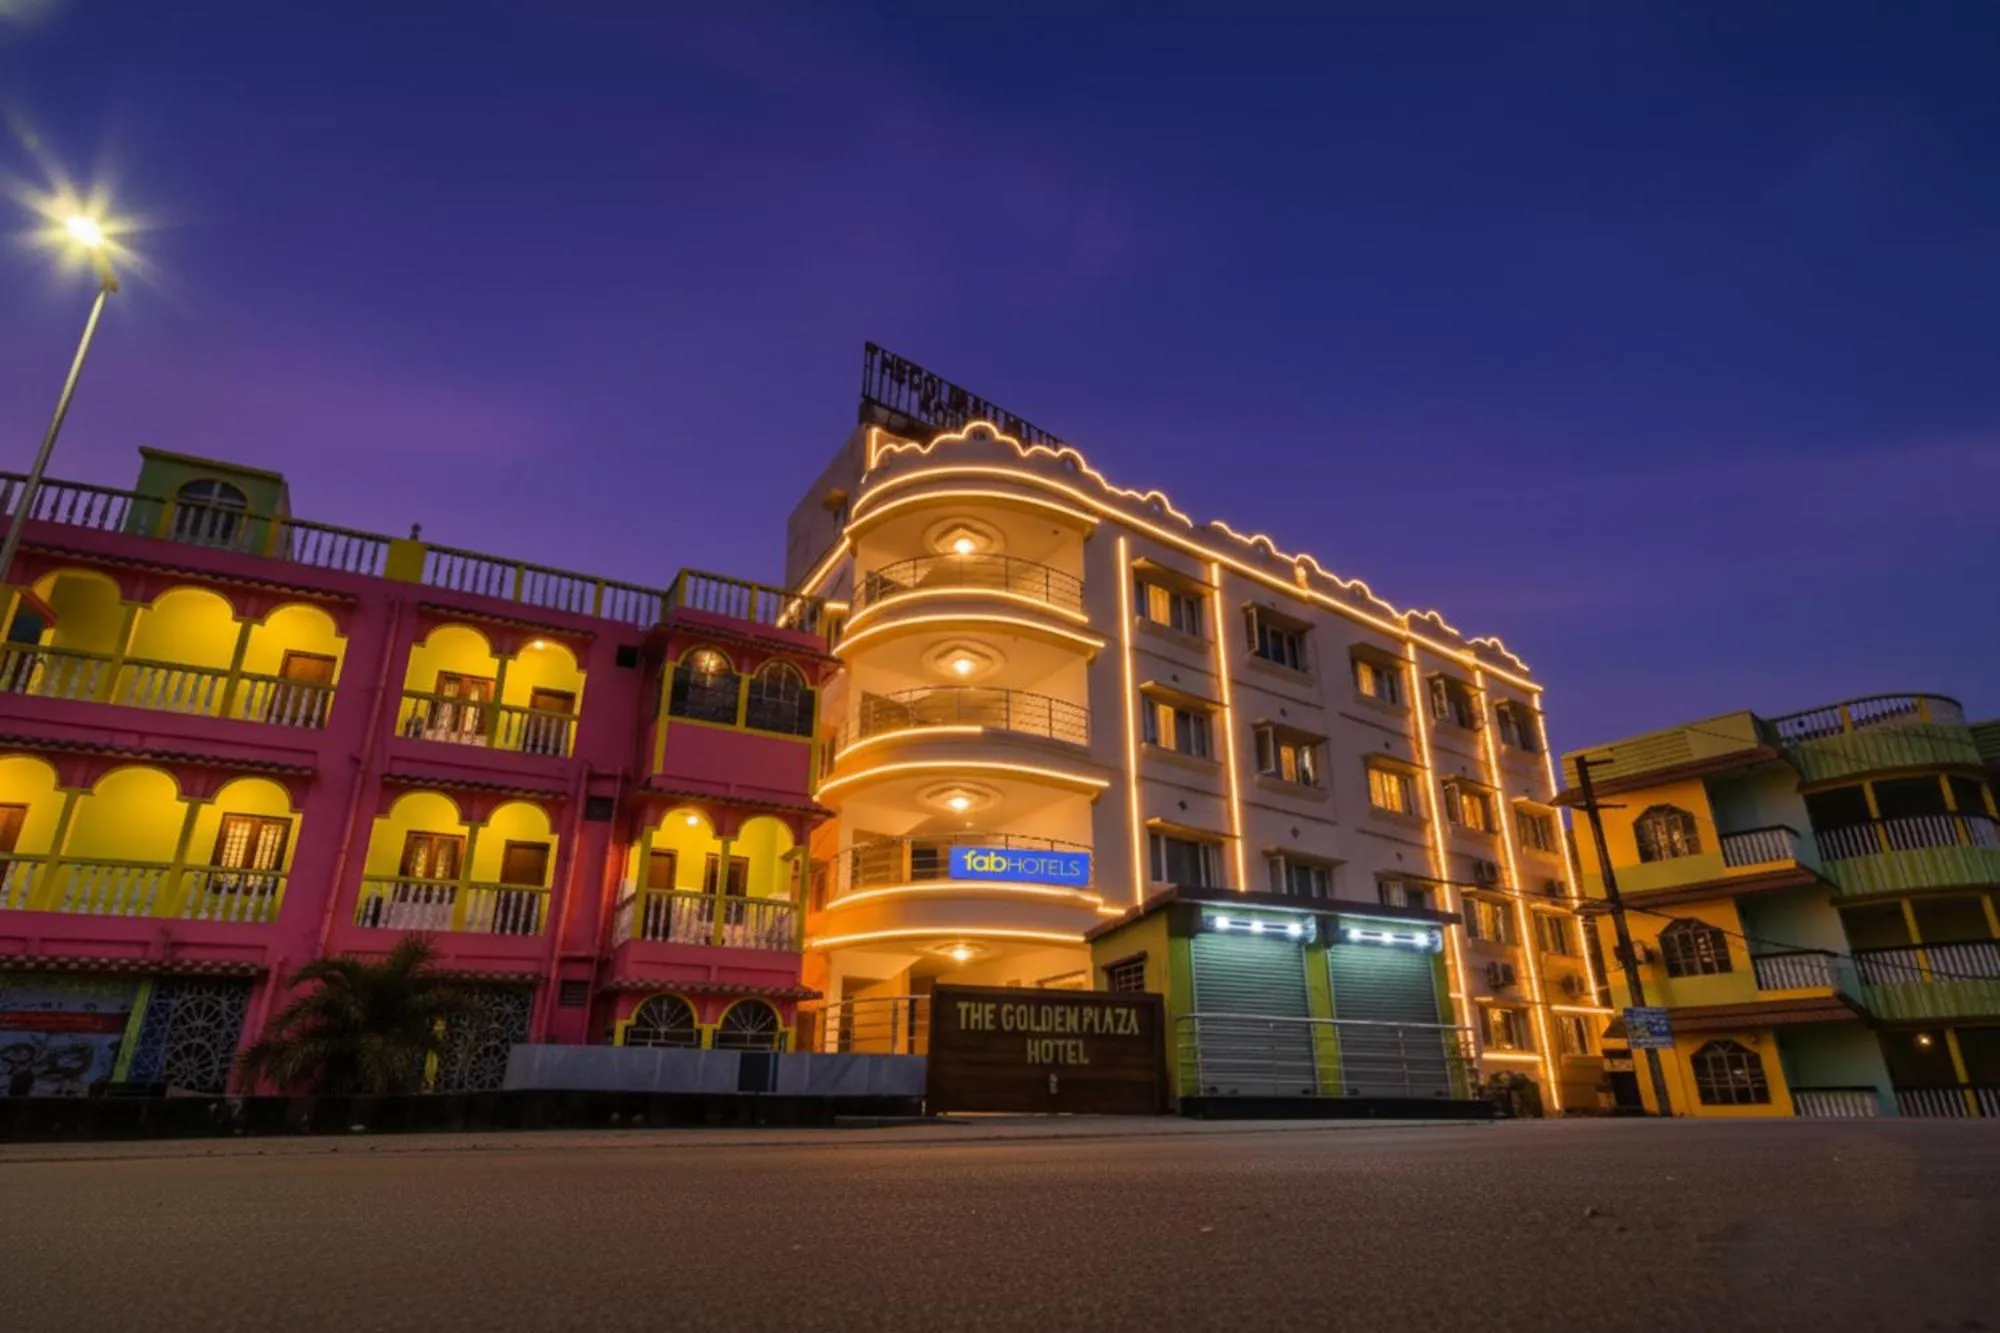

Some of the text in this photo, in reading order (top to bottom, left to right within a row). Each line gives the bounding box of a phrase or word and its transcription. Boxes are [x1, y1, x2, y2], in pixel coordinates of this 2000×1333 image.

[957, 1002, 1140, 1036] THE GOLDEN PLAZA
[1027, 1039, 1090, 1065] HOTEL
